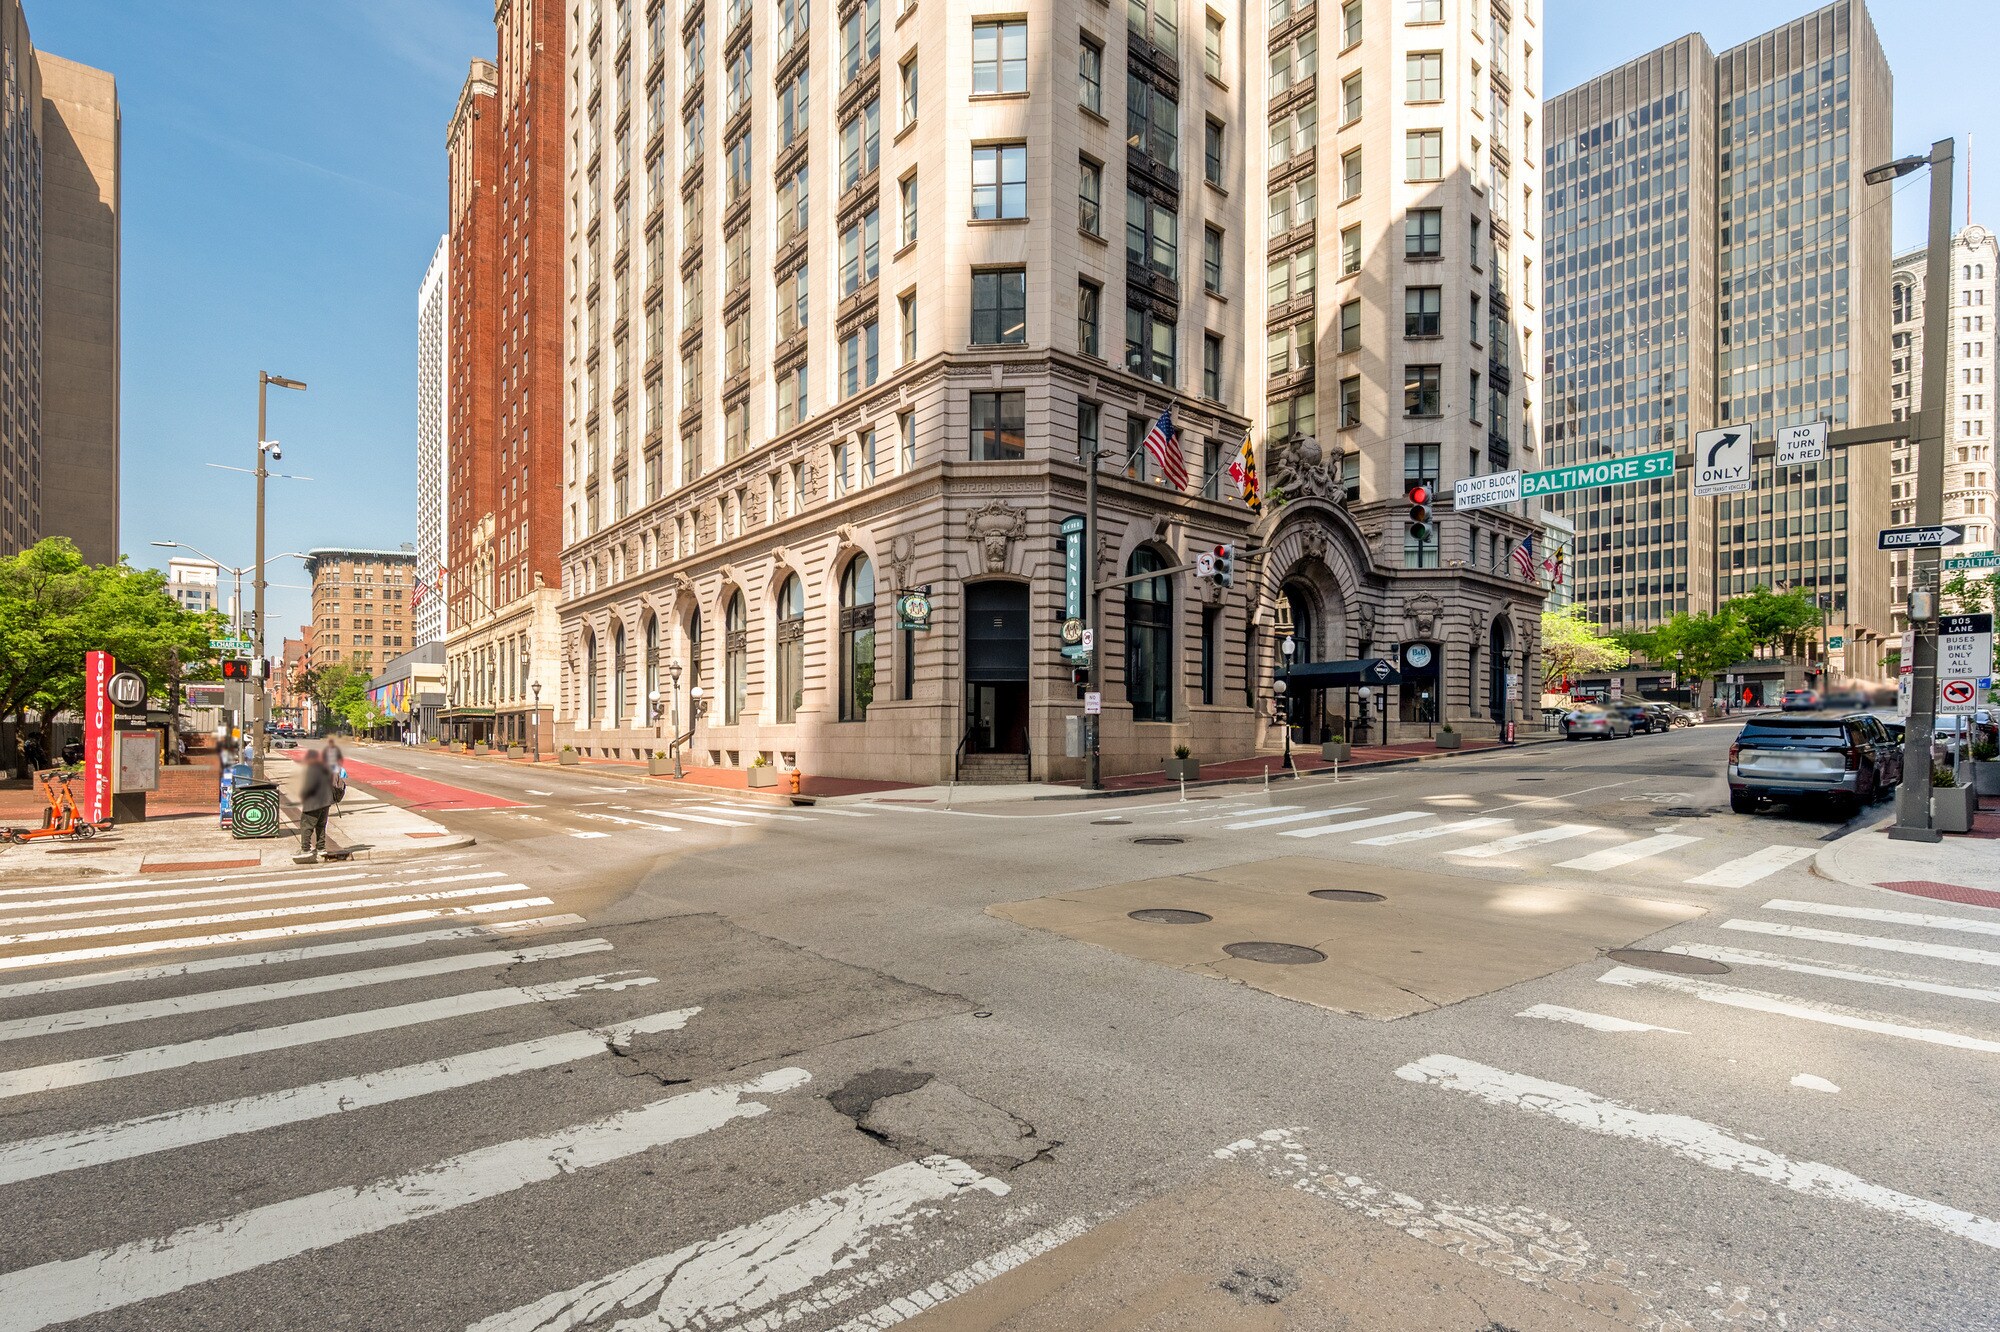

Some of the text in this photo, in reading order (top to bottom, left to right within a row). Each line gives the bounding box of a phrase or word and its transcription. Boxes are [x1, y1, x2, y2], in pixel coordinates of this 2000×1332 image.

[1793, 428, 1810, 438] NO
[1787, 439, 1815, 449] TURN
[1780, 449, 1821, 461] ON RED
[1523, 457, 1672, 494] BALTIMORE ST.
[1702, 466, 1743, 481] ONLY
[1457, 475, 1517, 494] DO NOT BLOCK
[1728, 483, 1747, 491] VEHICLES
[1458, 490, 1515, 506] INTERSECTION
[1887, 532, 1945, 544] ONE WAY
[1069, 534, 1079, 616] MONACO
[1948, 625, 1973, 633] LANE
[1947, 644, 1974, 652] BIKES
[240, 664, 248, 677] 4
[118, 678, 140, 702] M
[93, 651, 105, 824] Charles Center
